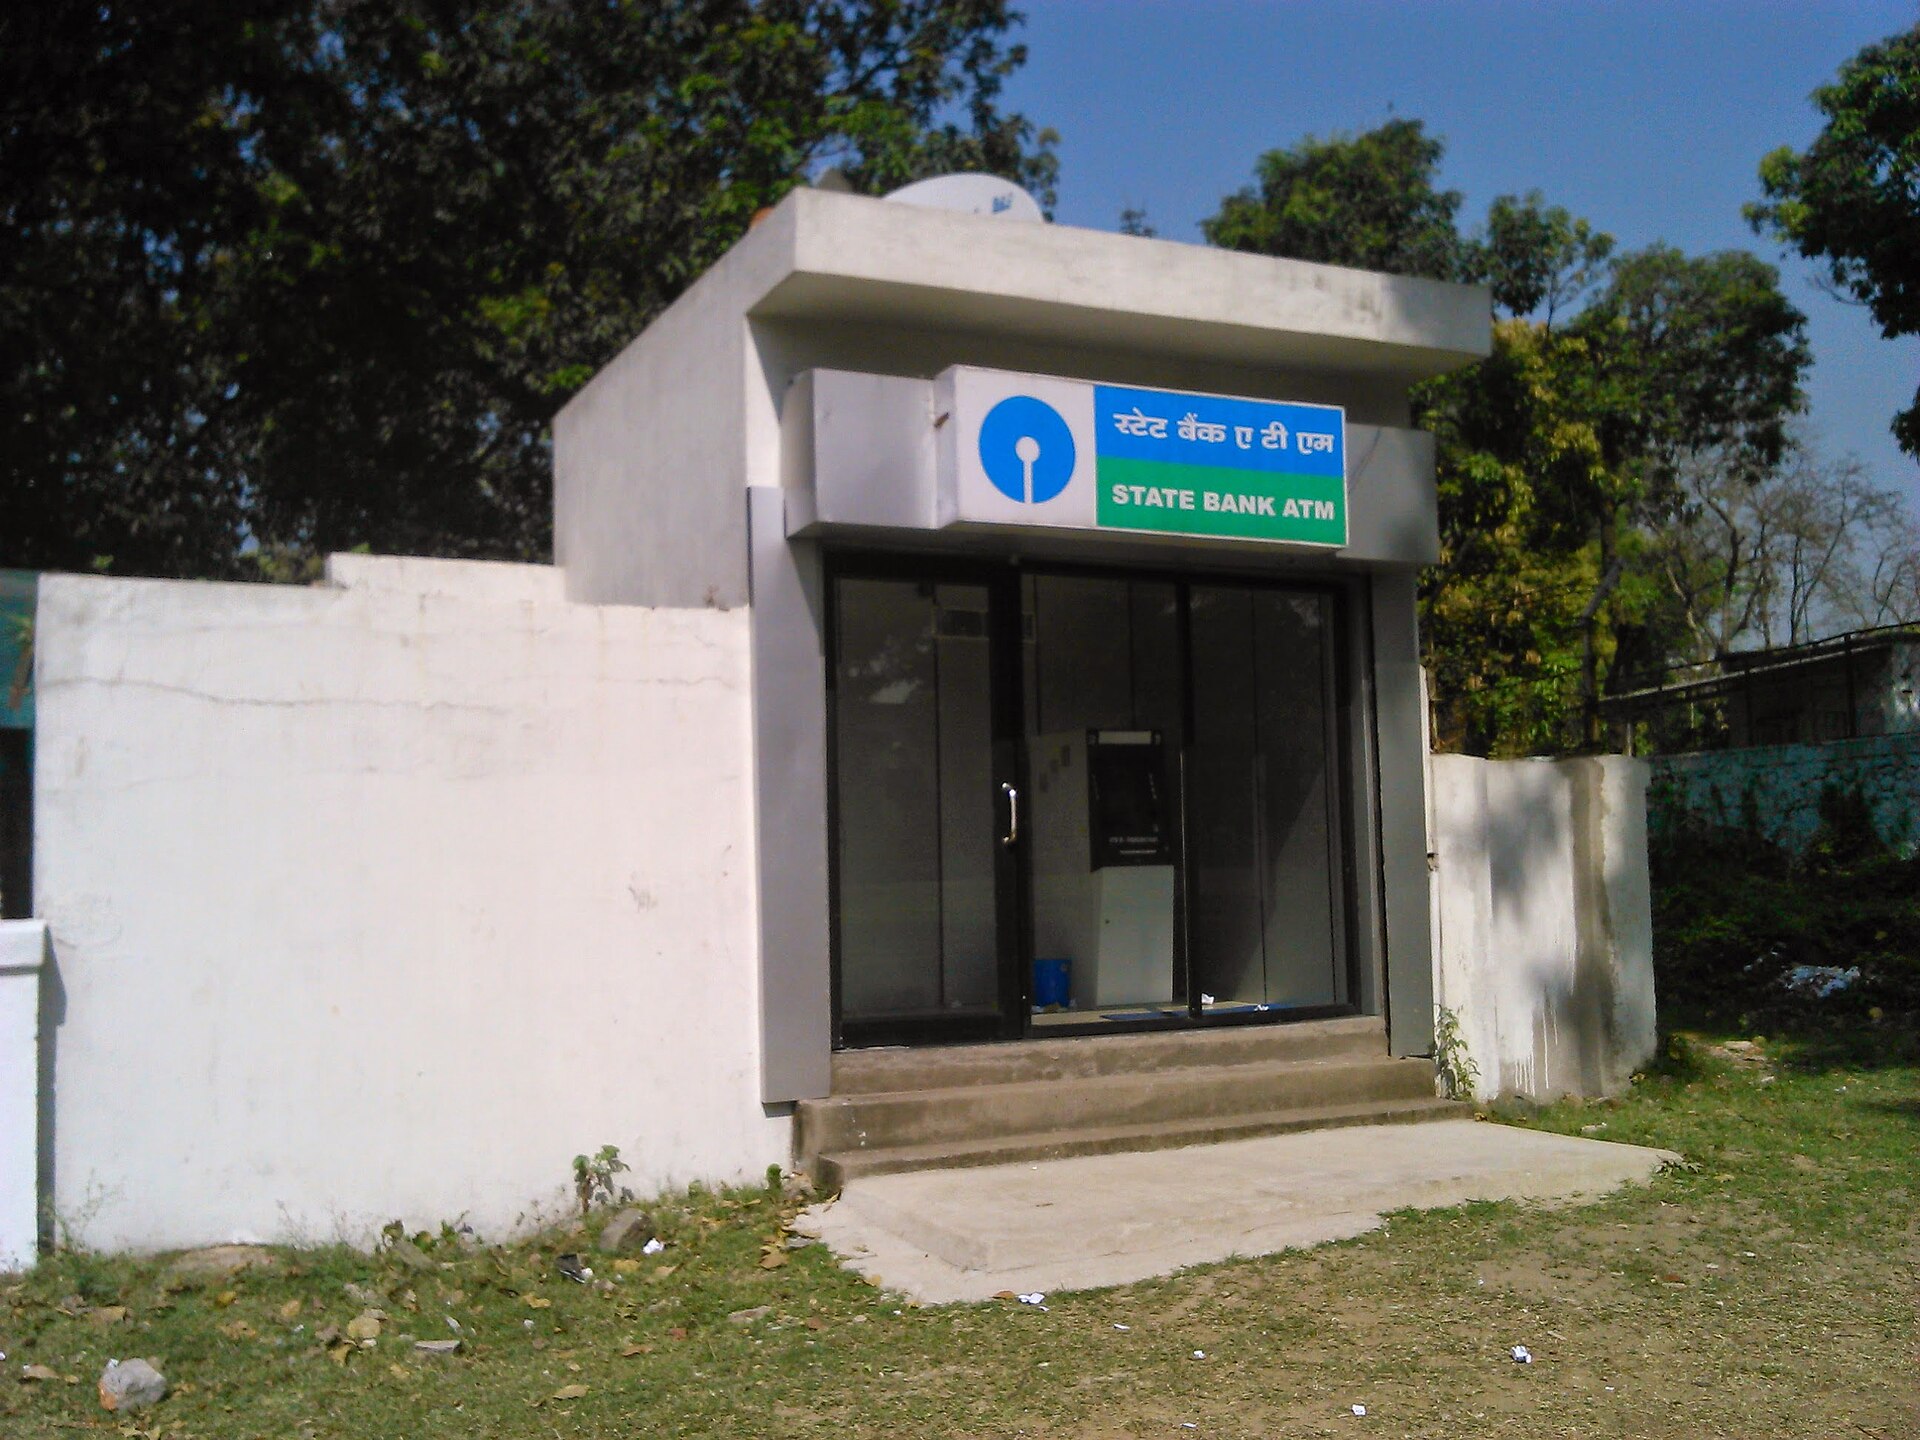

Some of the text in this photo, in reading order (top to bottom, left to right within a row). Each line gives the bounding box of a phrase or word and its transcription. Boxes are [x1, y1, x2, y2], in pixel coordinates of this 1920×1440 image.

[1113, 407, 1335, 454] स्टेट बैंक ए टी एम
[1112, 484, 1335, 520] STATE BANK ATM
